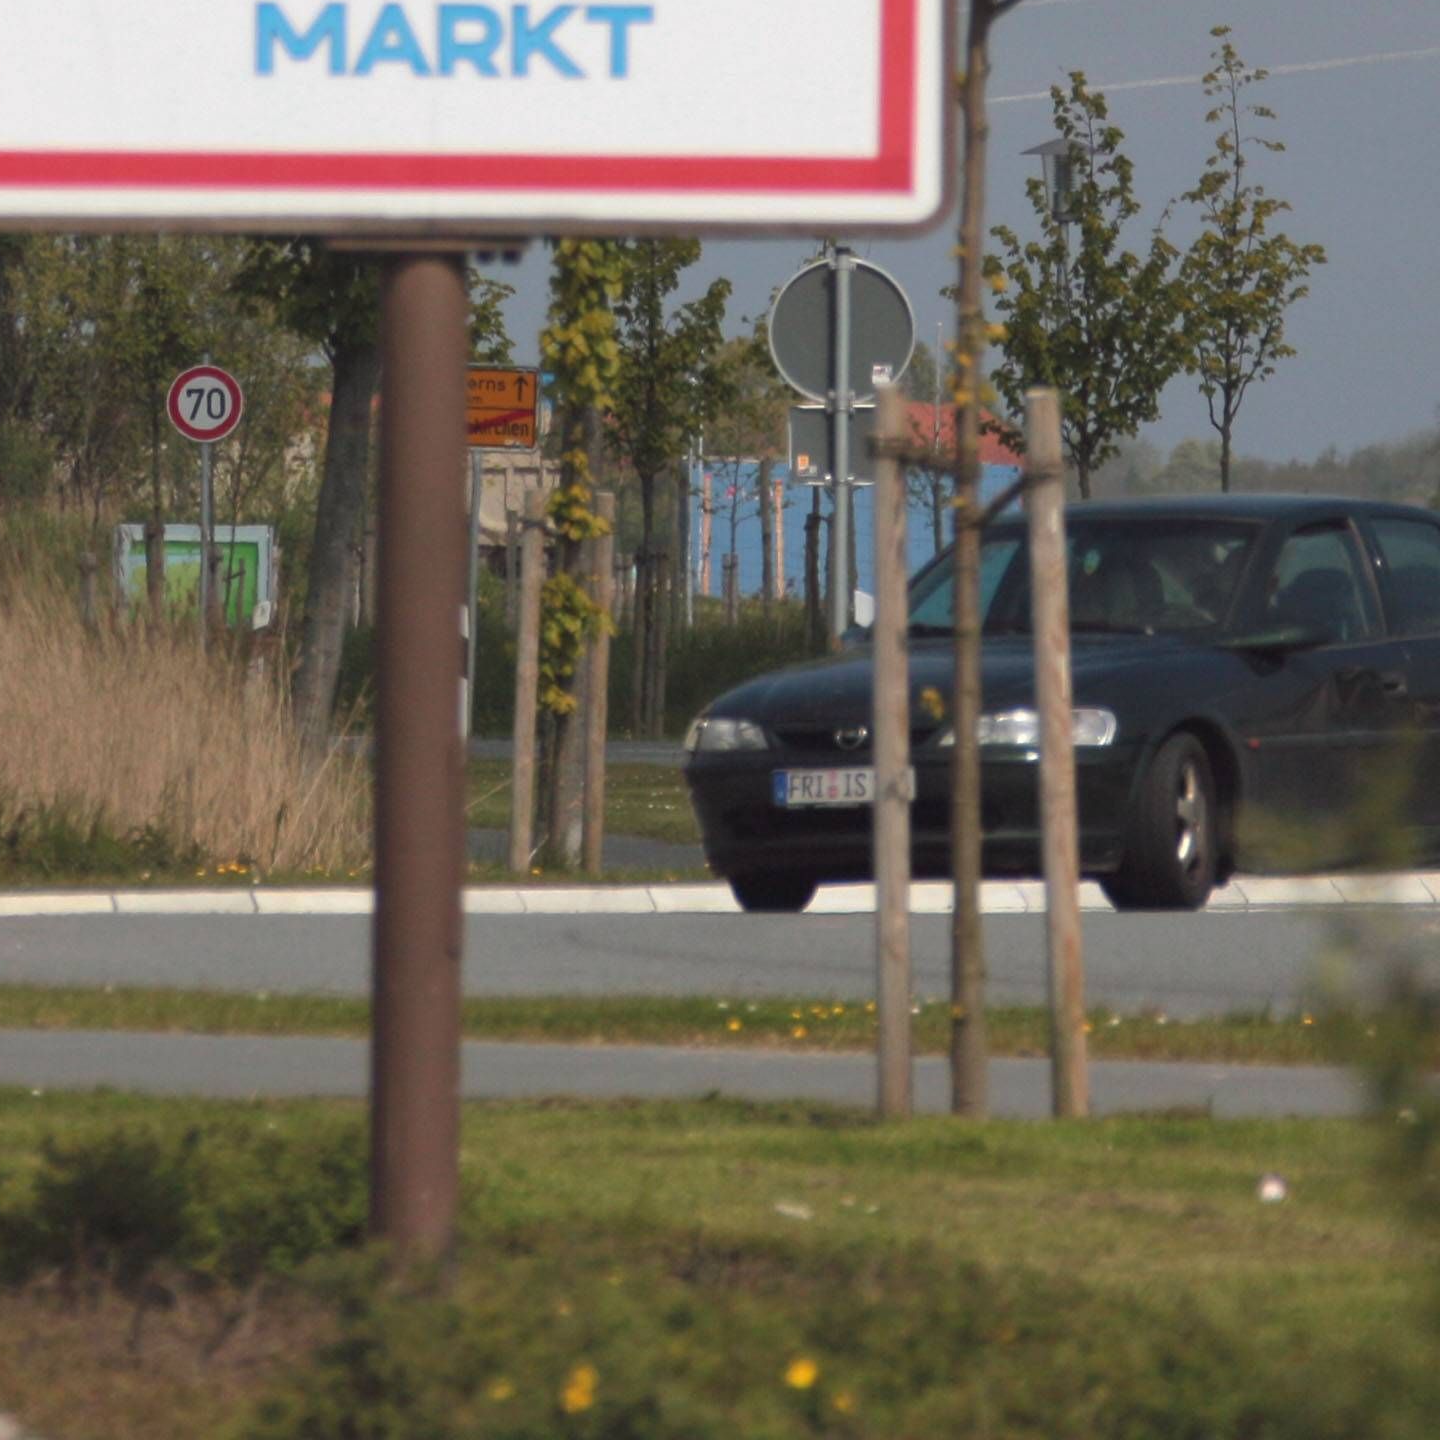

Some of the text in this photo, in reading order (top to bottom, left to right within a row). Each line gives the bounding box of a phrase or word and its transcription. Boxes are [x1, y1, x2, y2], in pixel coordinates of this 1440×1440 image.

[254, 1, 653, 79] MARKT
[186, 387, 226, 421] 70
[789, 774, 824, 799] FRI
[843, 772, 868, 798] IS
